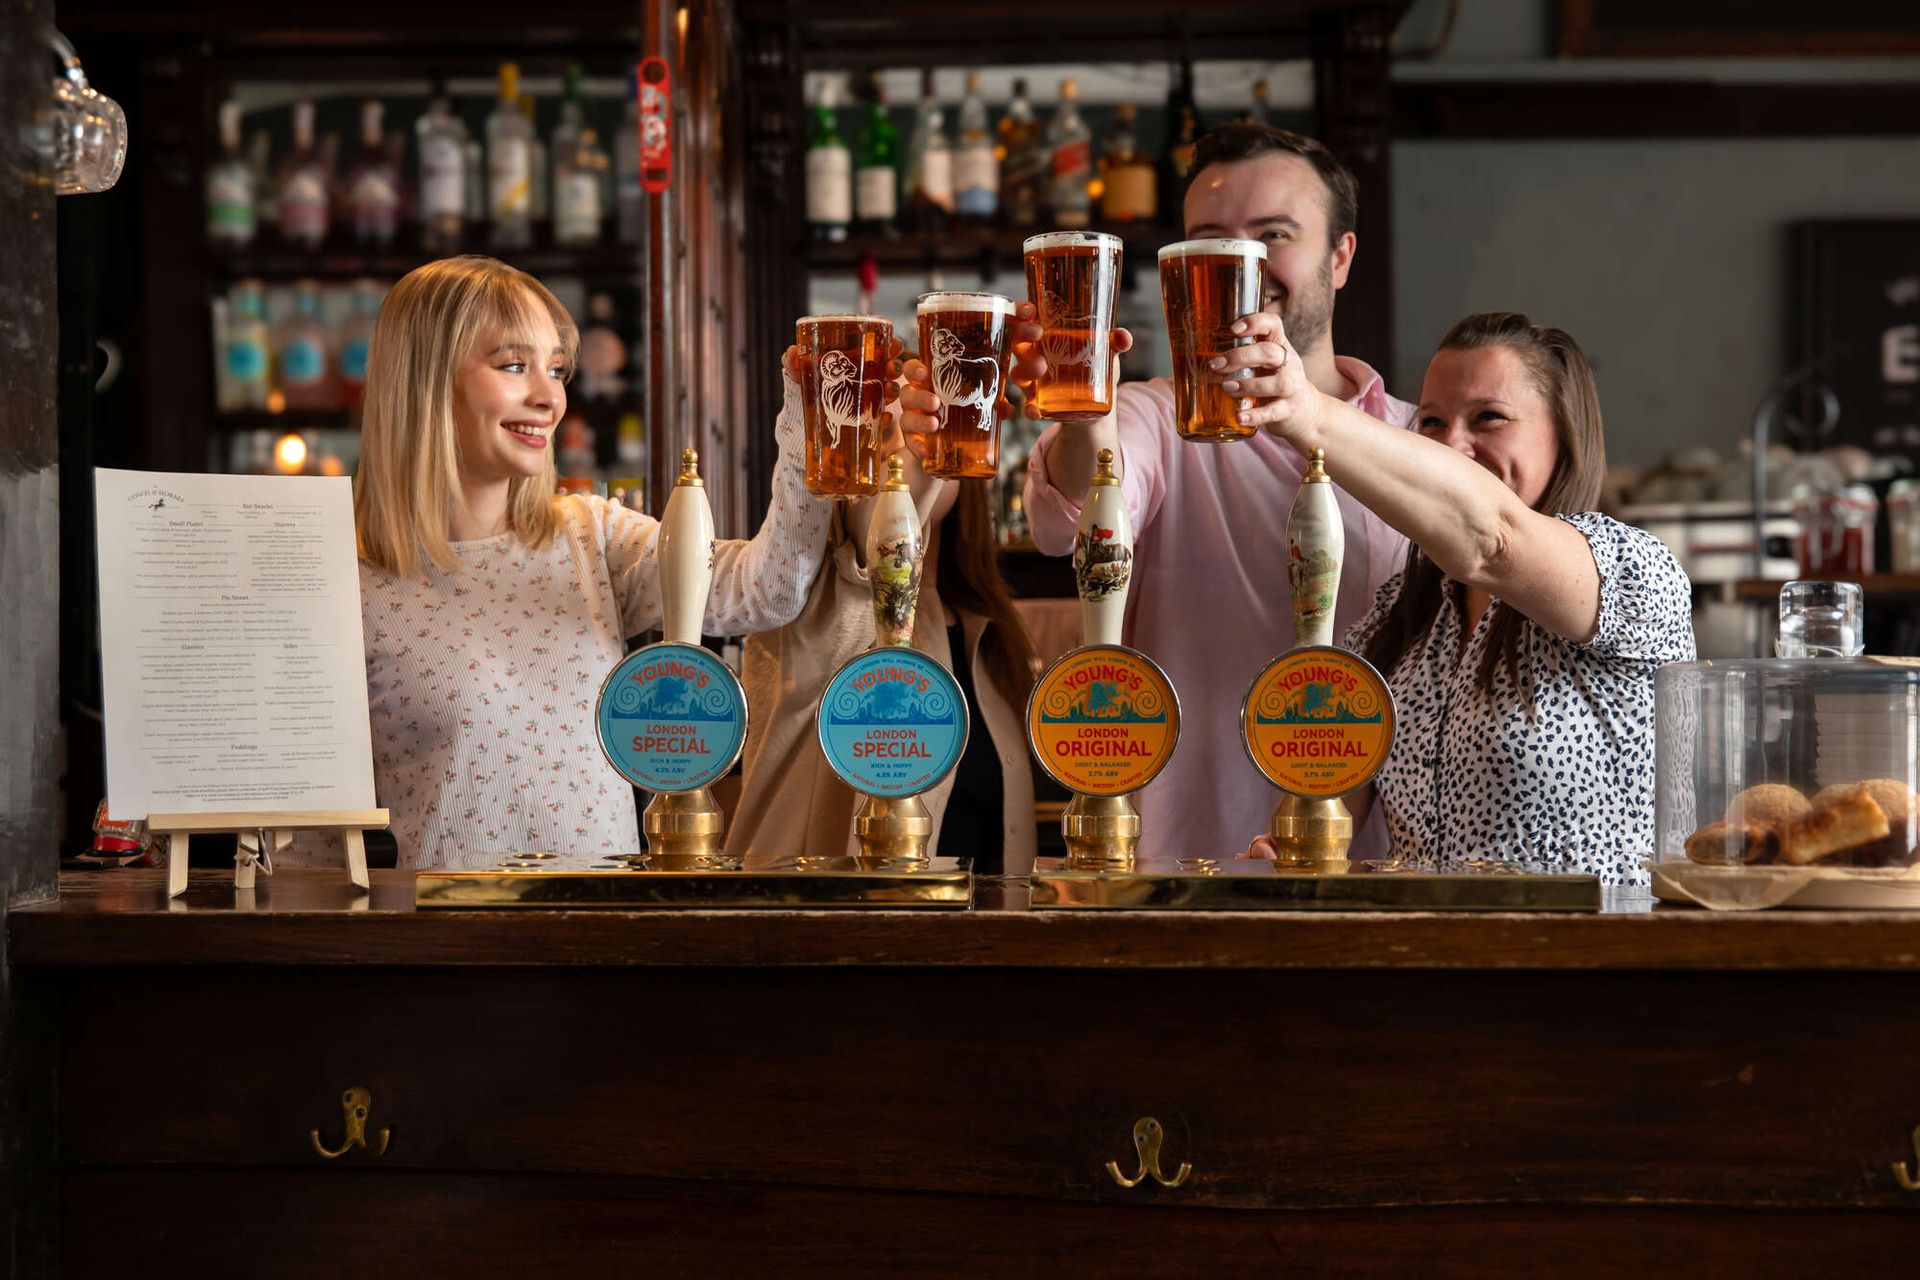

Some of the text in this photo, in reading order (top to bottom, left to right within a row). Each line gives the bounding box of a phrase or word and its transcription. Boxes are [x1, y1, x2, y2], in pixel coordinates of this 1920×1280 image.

[632, 660, 710, 688] YOUNG'S
[852, 666, 931, 692] YOUNG'S
[1063, 664, 1143, 692] YOUNG'S
[1278, 666, 1358, 692] YOUNG'S
[646, 725, 696, 736] LONDON
[866, 729, 916, 740] LONDON
[1078, 728, 1129, 739] LONDON
[1293, 728, 1345, 740] LONDON
[632, 736, 710, 754] SPECIAL
[852, 742, 932, 758] SPECIAL
[1056, 740, 1152, 758] ORIGINAL
[1270, 740, 1368, 758] ORIGINAL
